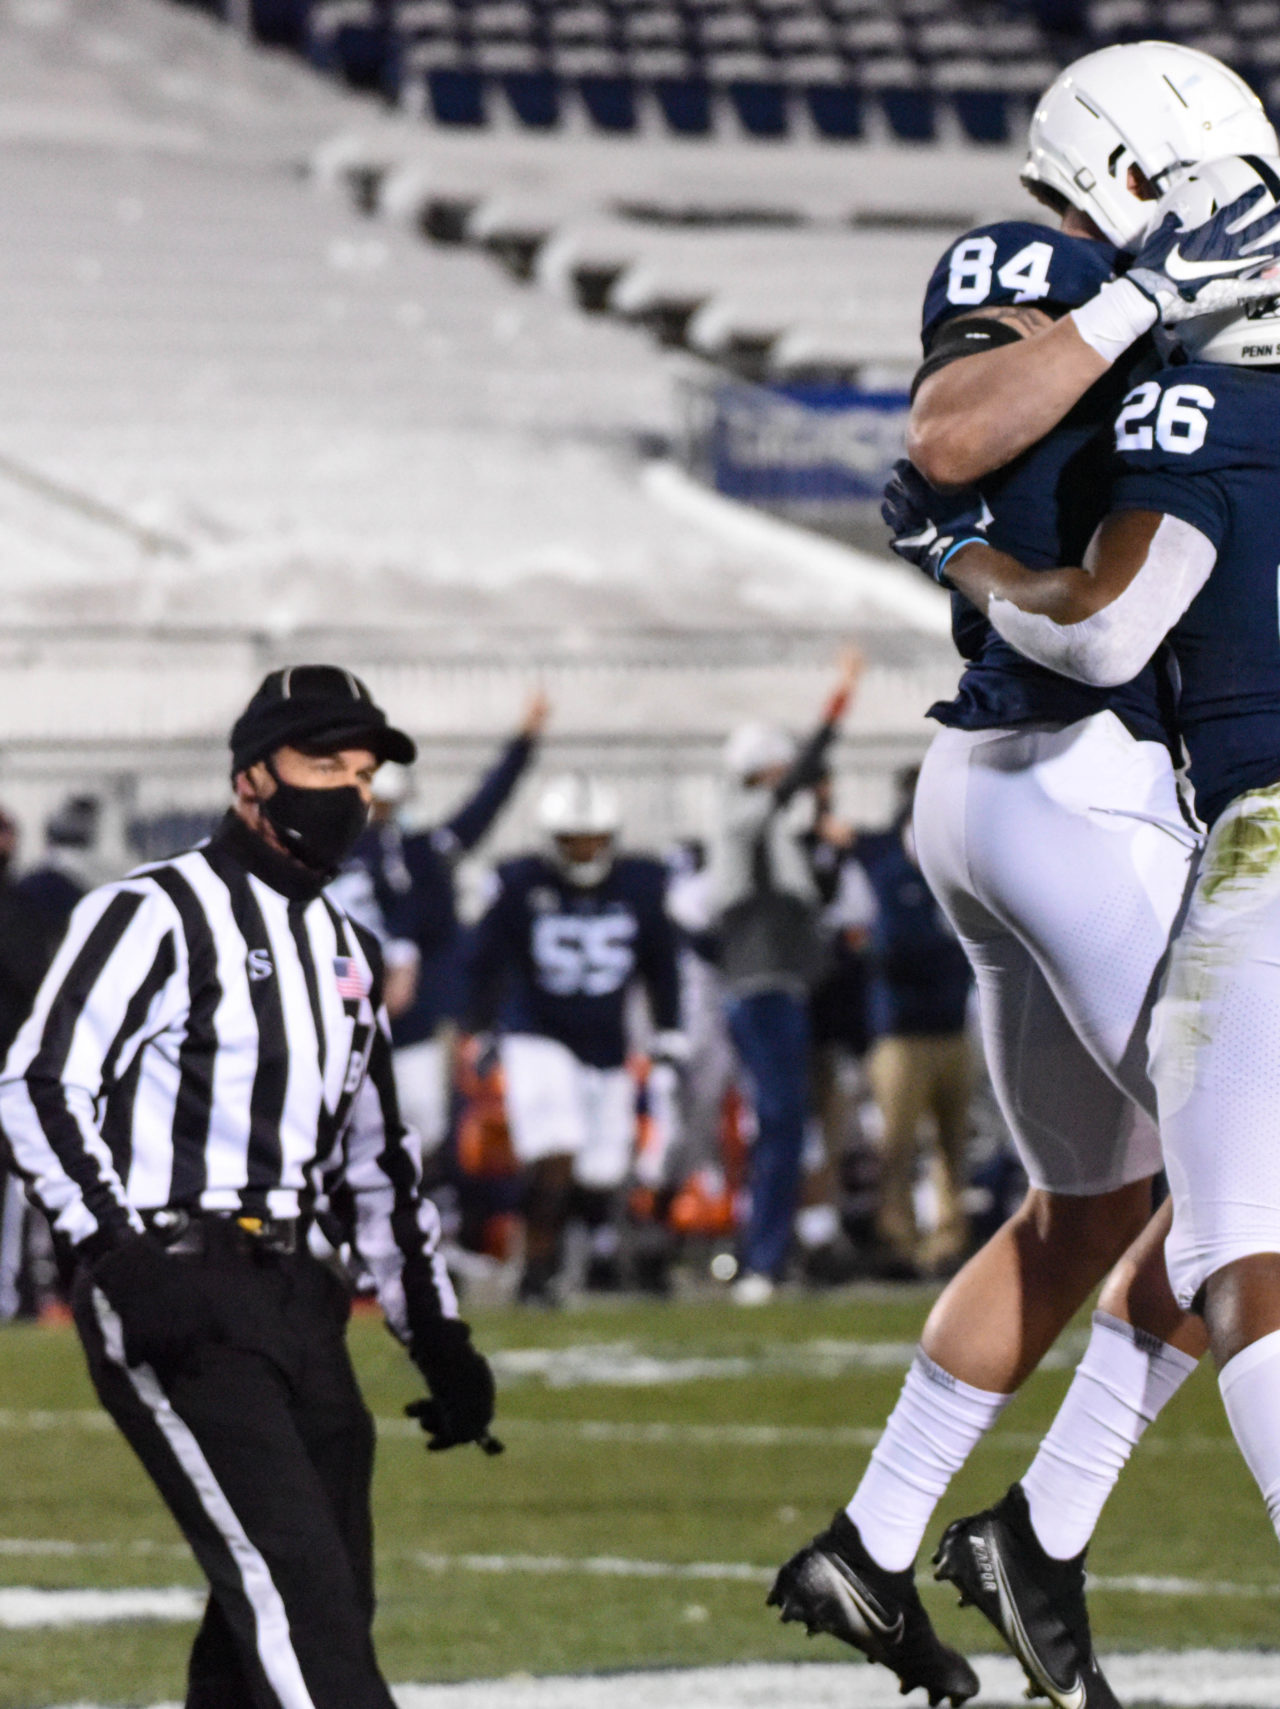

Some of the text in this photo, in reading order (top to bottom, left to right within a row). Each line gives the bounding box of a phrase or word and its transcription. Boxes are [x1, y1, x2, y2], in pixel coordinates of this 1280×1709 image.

[947, 235, 1053, 307] 84
[1241, 346, 1273, 358] PENN
[1115, 382, 1215, 455] 26
[248, 949, 273, 982] S
[531, 914, 638, 996] 55
